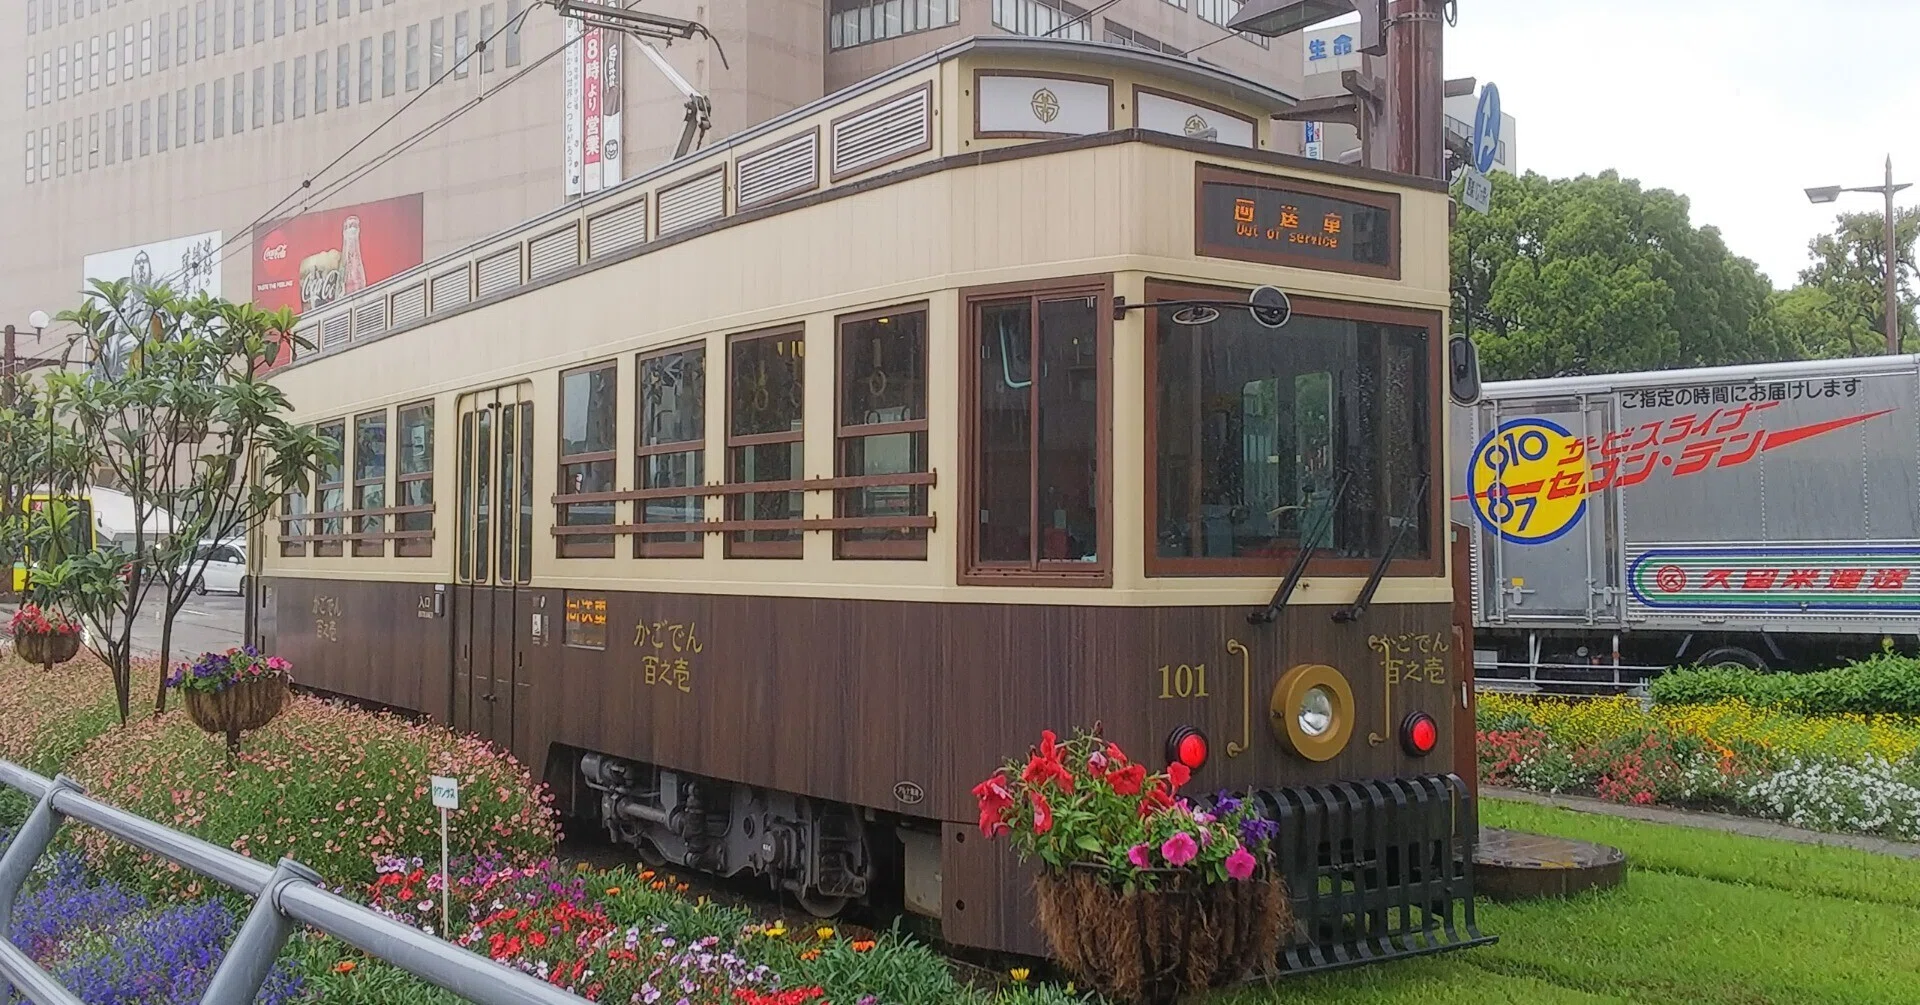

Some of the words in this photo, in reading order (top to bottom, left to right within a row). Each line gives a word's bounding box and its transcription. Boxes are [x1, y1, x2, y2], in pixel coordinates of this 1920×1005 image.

[1308, 34, 1353, 61] 生命
[1289, 231, 1338, 248] service
[1622, 379, 1861, 409] ご指定の時間にお届けします
[1484, 430, 1549, 481] 910
[1487, 482, 1538, 532] 87
[1700, 568, 1912, 590] 久留米運送
[633, 619, 703, 653] かごでん
[1158, 664, 1209, 699] 101
